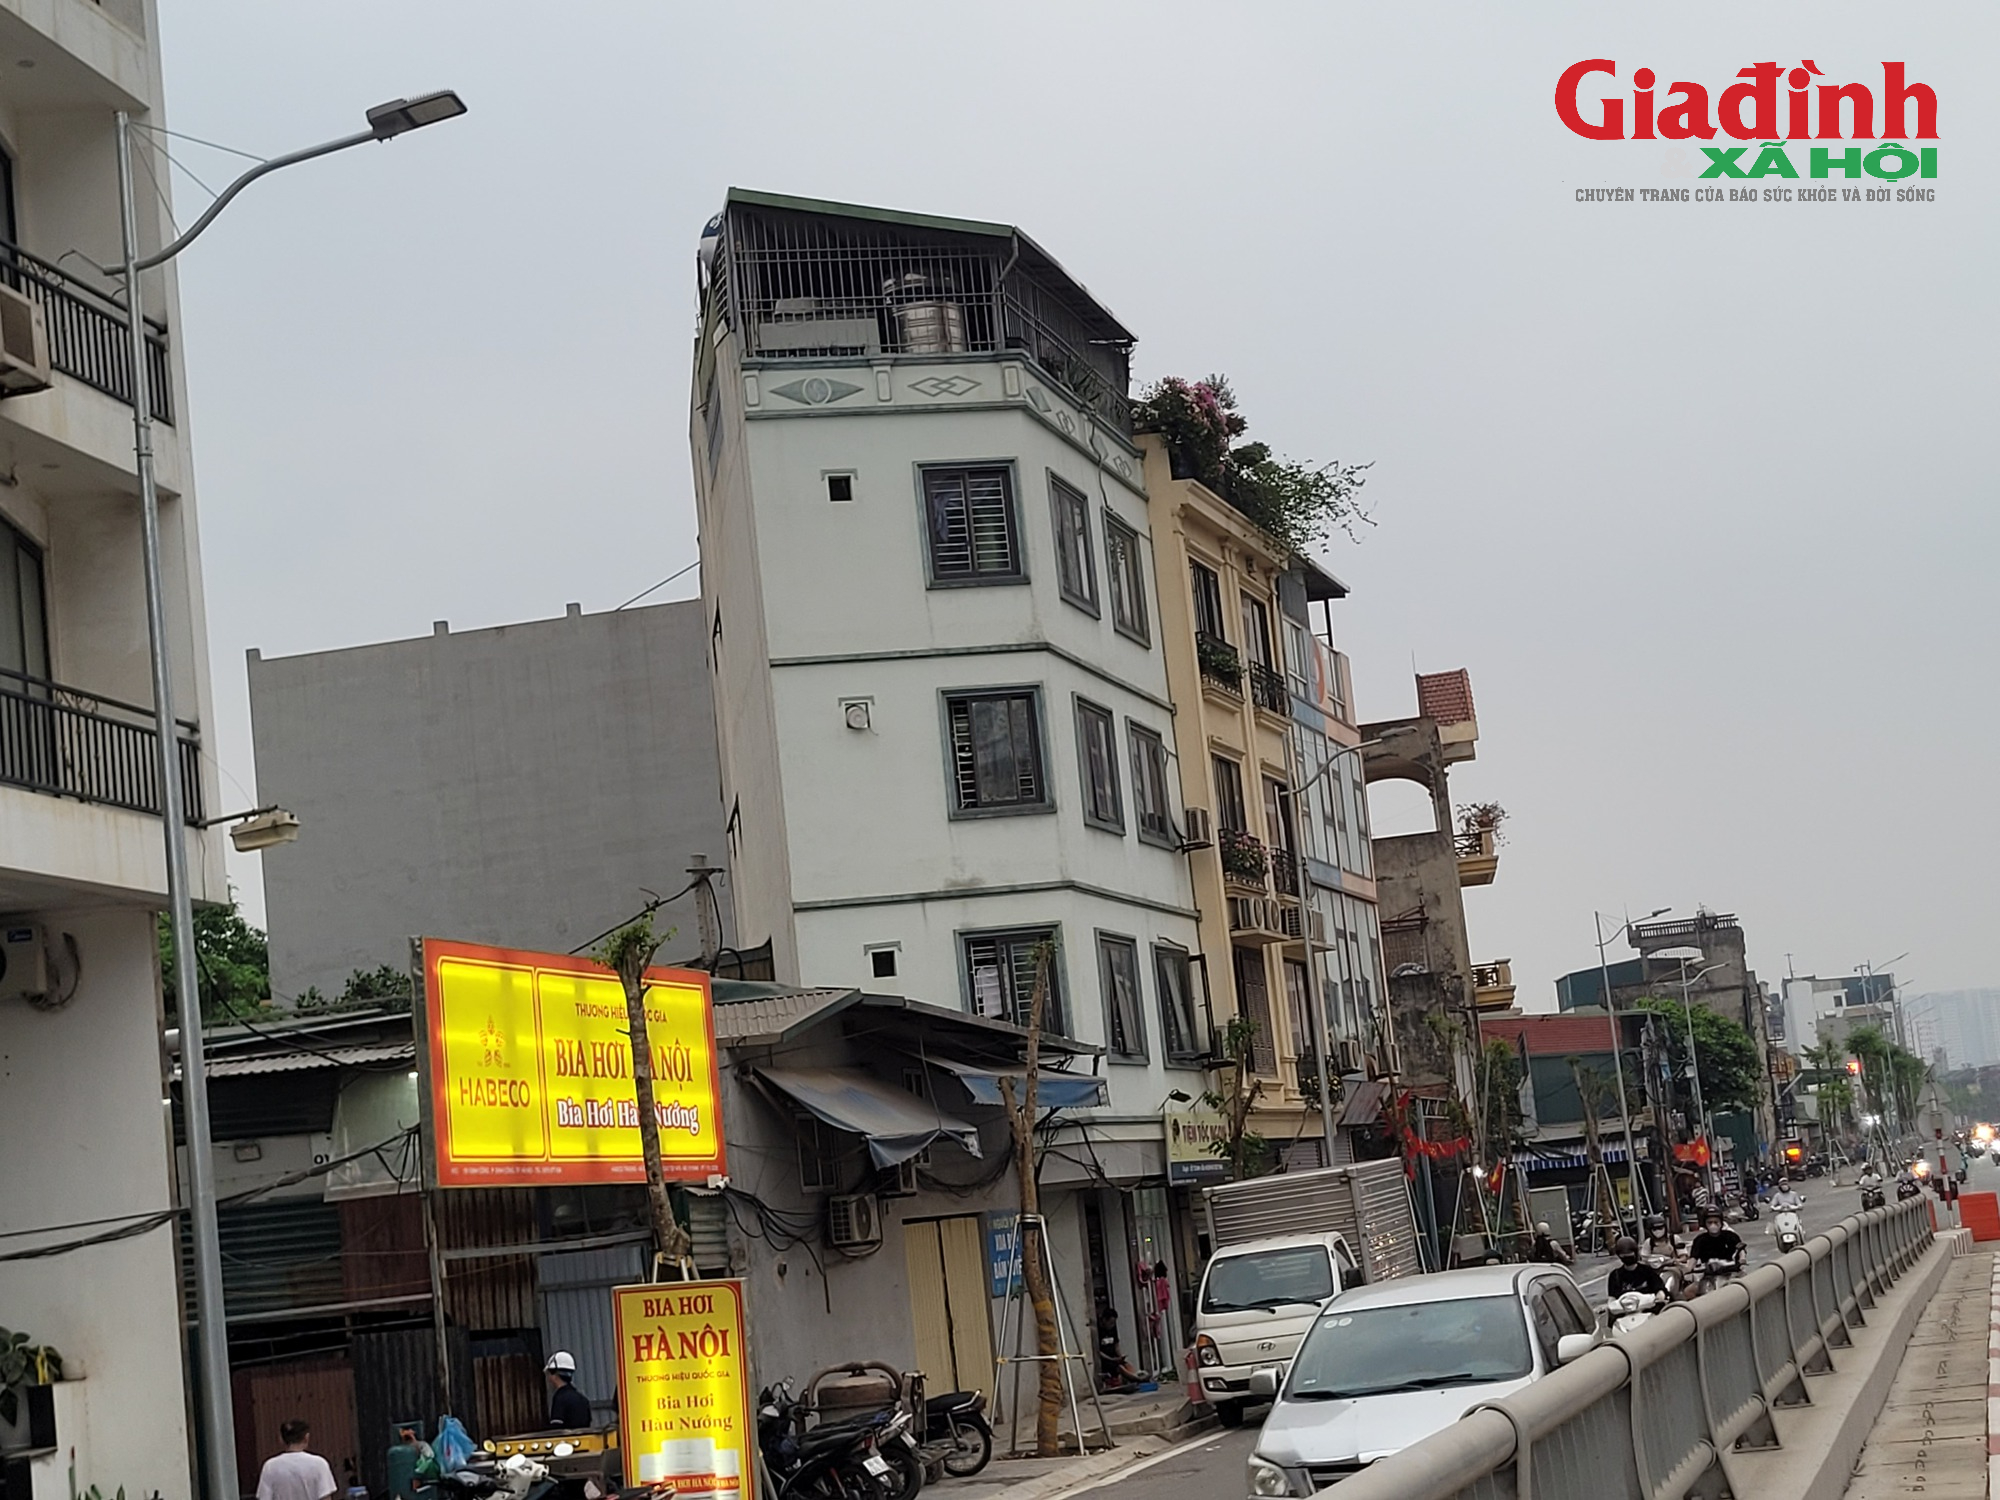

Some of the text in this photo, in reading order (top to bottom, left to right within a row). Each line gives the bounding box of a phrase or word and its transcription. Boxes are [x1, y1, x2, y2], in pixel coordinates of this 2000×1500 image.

[654, 1010, 667, 1022] GIA
[554, 1039, 589, 1077] BIA
[590, 1040, 628, 1079] HƠI
[659, 1038, 693, 1091] NỘI
[459, 1076, 531, 1108] HABECO
[556, 1097, 584, 1127] Bia
[586, 1097, 615, 1127] Hơi
[643, 1294, 714, 1317] BIA HƠI
[632, 1323, 730, 1365] HÀ NỘI
[657, 1393, 714, 1410] Bia Hơi
[641, 1414, 733, 1432] Hàu Nướng
